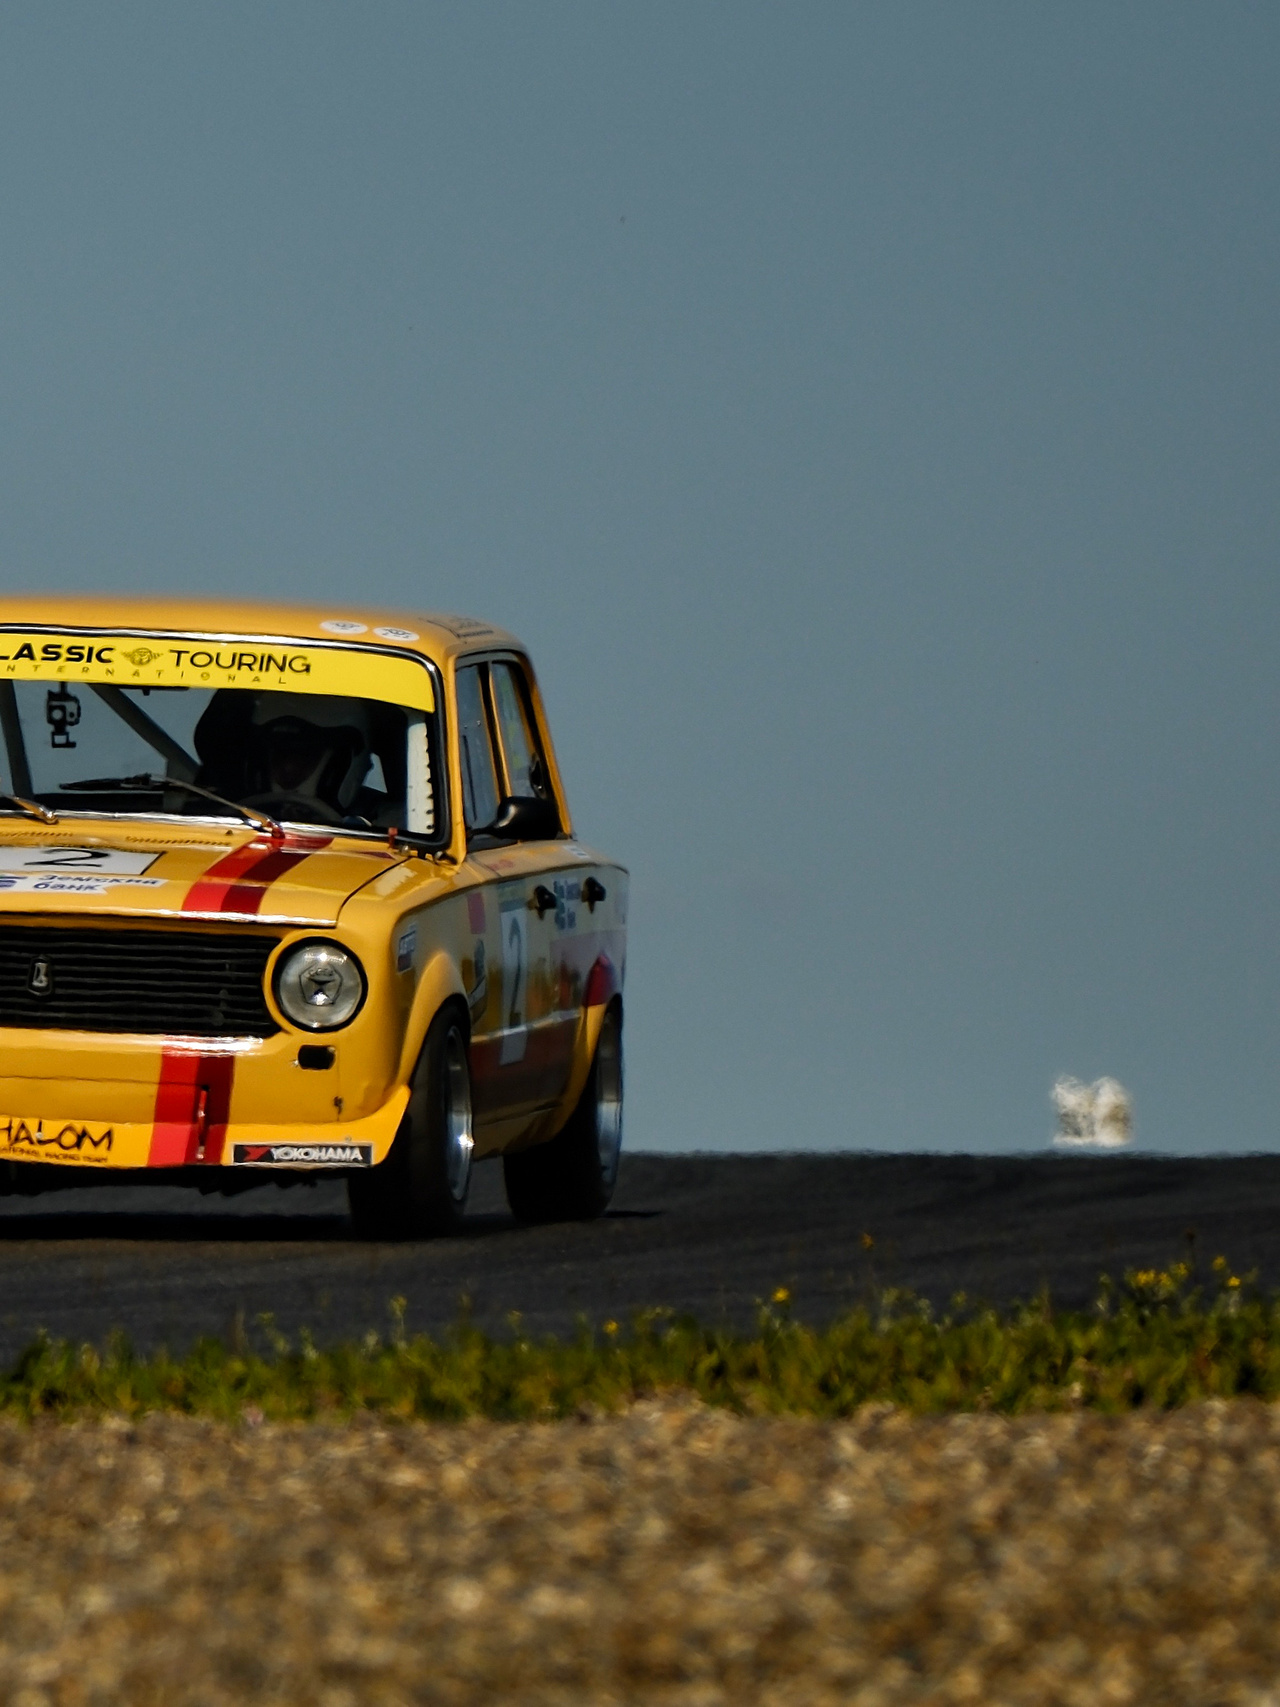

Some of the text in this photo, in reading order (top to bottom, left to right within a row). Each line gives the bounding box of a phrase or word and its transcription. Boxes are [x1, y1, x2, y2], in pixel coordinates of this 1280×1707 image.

[169, 649, 311, 674] TOURING
[24, 848, 111, 868] 2
[270, 1146, 364, 1161] YOKOHAMA
